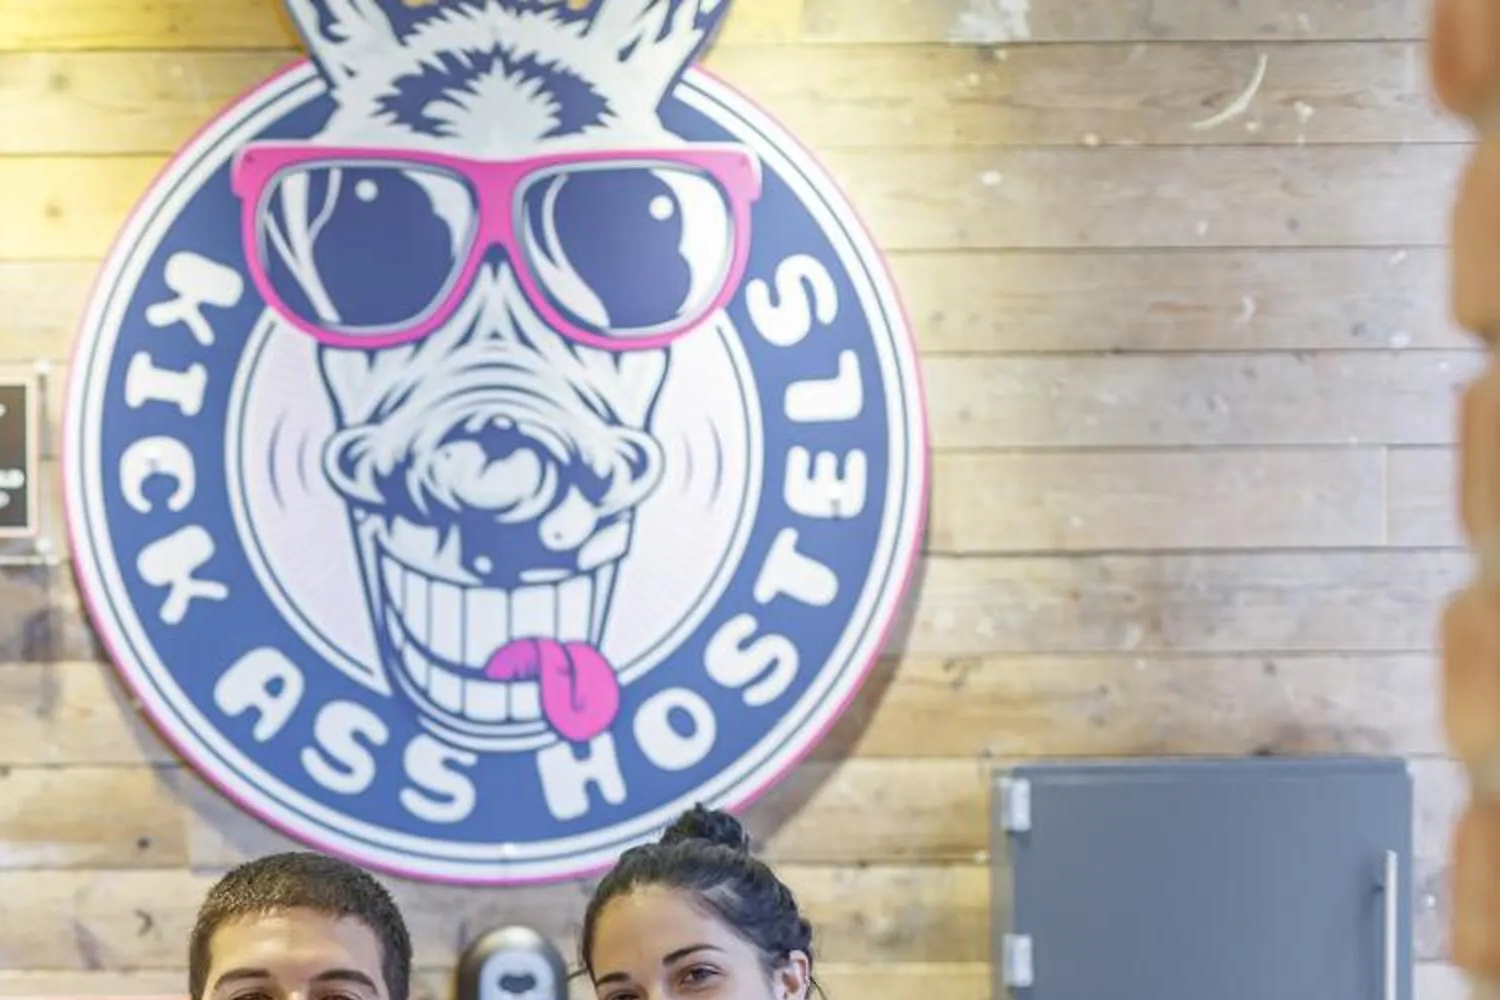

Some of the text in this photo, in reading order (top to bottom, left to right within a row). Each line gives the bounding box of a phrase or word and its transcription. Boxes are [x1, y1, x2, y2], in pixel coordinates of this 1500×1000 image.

[120, 251, 867, 824] KICK ASS HOSTELS
